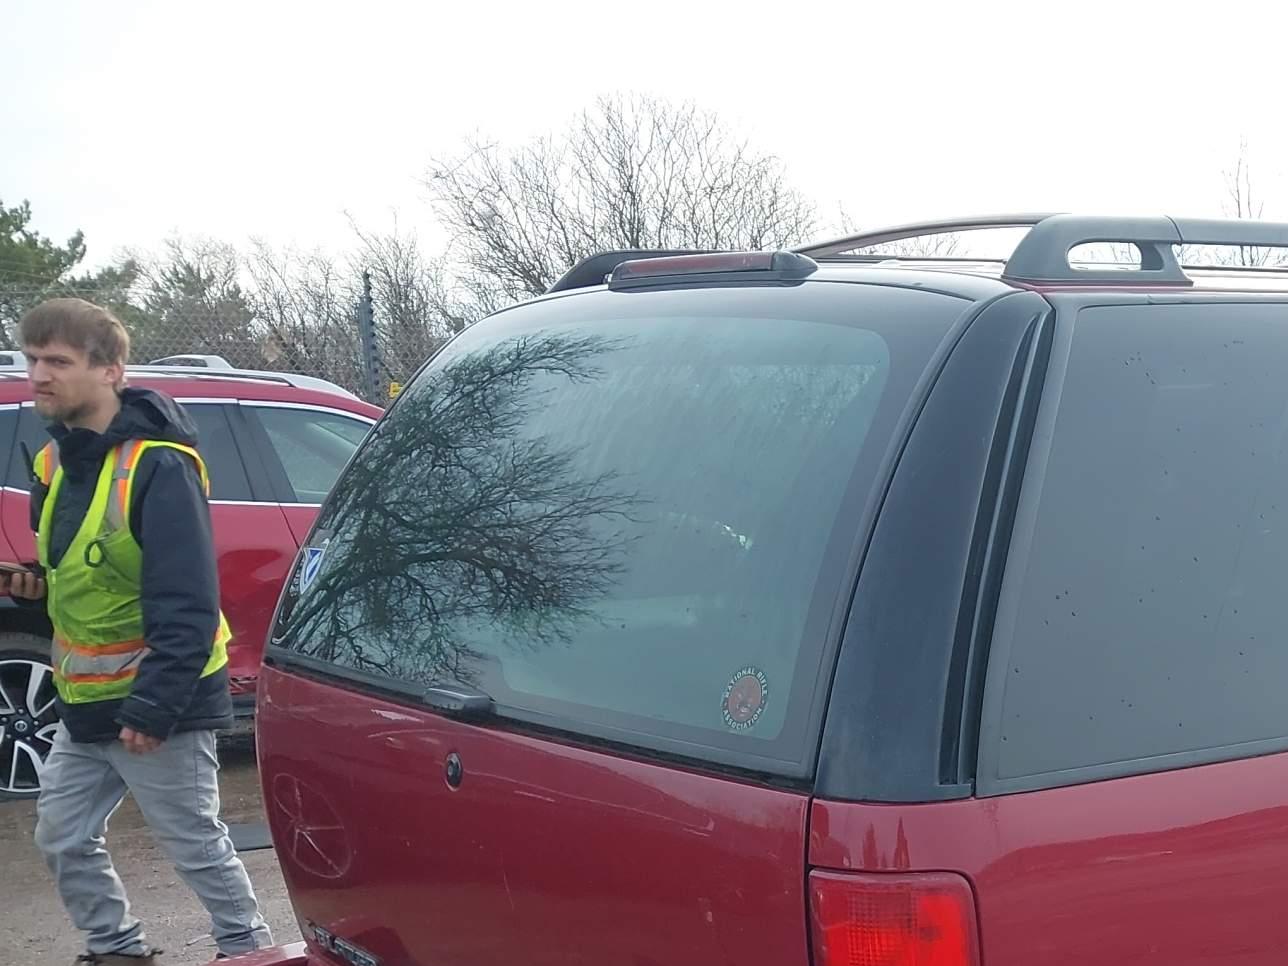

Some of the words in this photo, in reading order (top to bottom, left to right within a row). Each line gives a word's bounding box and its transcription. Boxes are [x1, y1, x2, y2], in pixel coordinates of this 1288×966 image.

[724, 667, 755, 698] NATIONAL
[756, 671, 768, 697] RIFLE
[722, 707, 762, 730] ASSOCIATION
